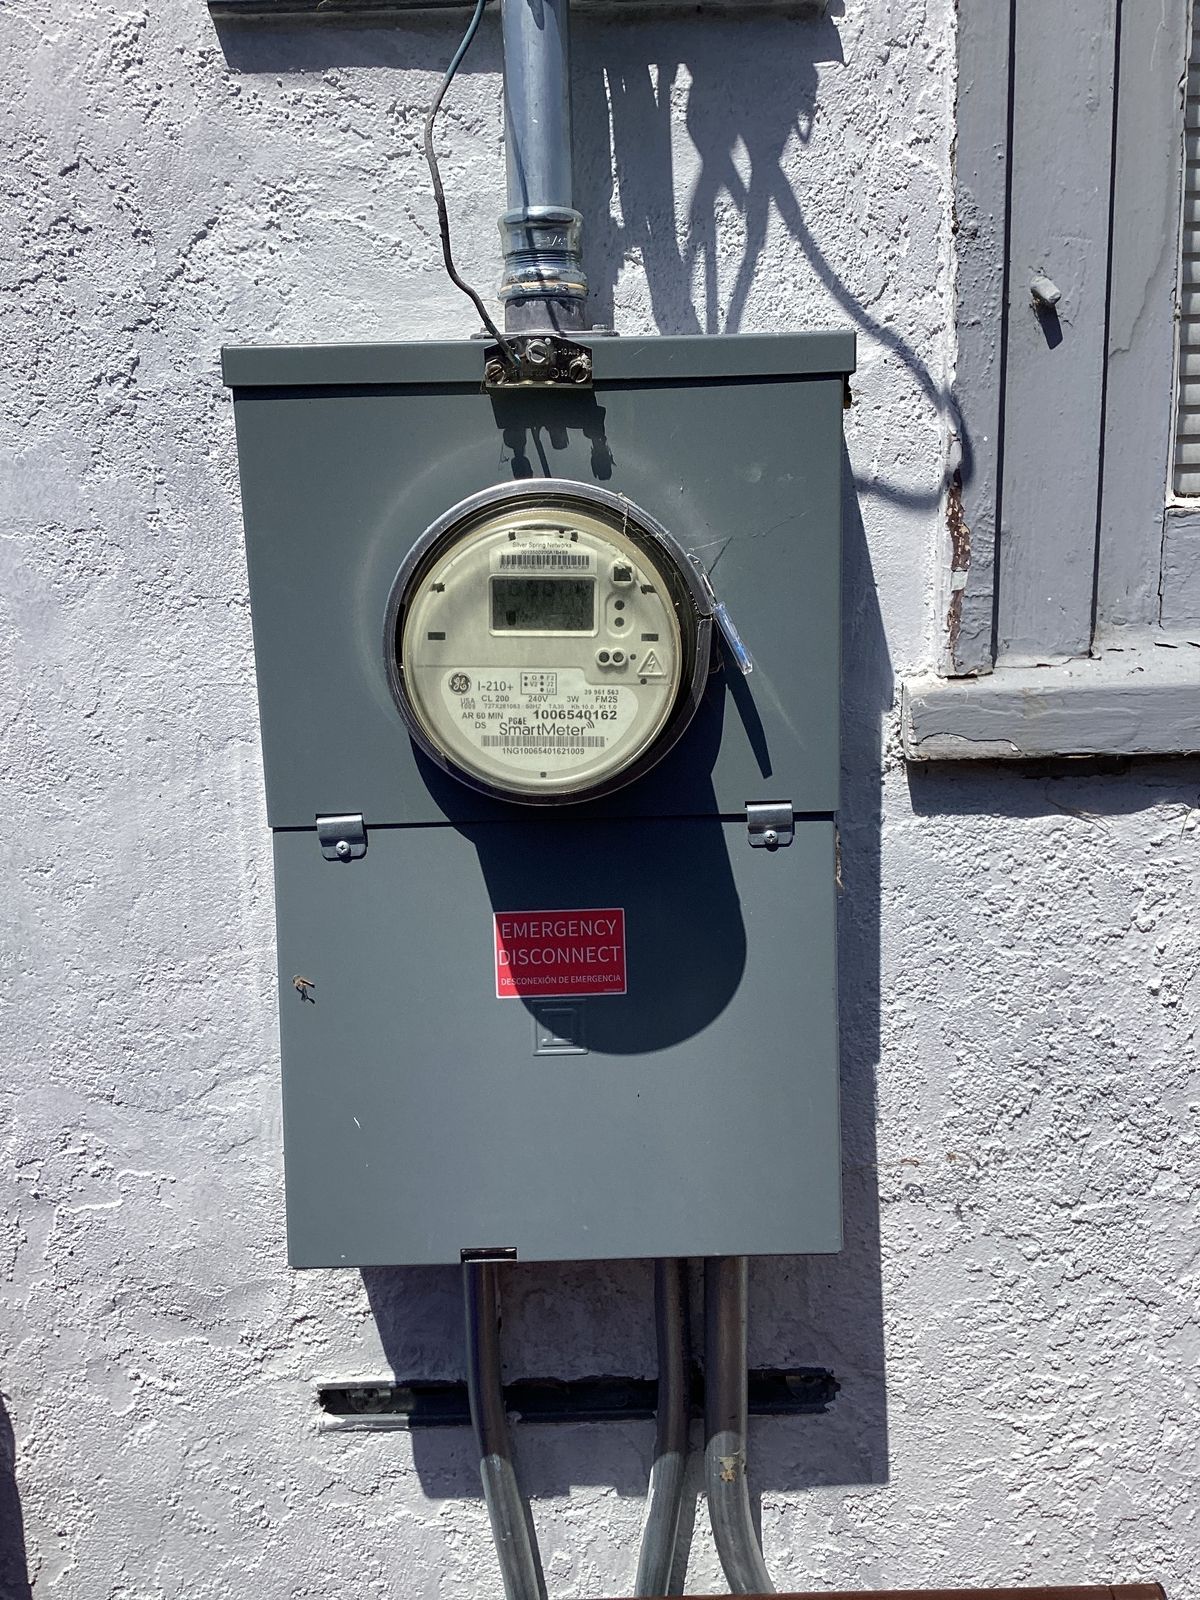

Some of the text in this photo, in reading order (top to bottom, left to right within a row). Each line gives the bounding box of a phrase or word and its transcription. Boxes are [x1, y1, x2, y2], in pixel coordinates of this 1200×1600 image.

[529, 541, 545, 549] Spring
[481, 694, 510, 703] CL 200
[528, 694, 549, 703] 240V
[566, 695, 580, 703] 3W
[595, 695, 618, 703] FM2S
[462, 712, 504, 720] AR 60 MIN
[533, 710, 618, 721] 1006540162
[474, 721, 487, 730] DS
[508, 717, 527, 726] PG&E
[499, 722, 586, 737] SmartMeter
[502, 747, 585, 756] 1NG10065401621009
[501, 918, 617, 939] EMERGENCY
[498, 945, 621, 966] DISCONNECT
[501, 974, 622, 986] DESCONEXIÓN DE EMERGENCIA
